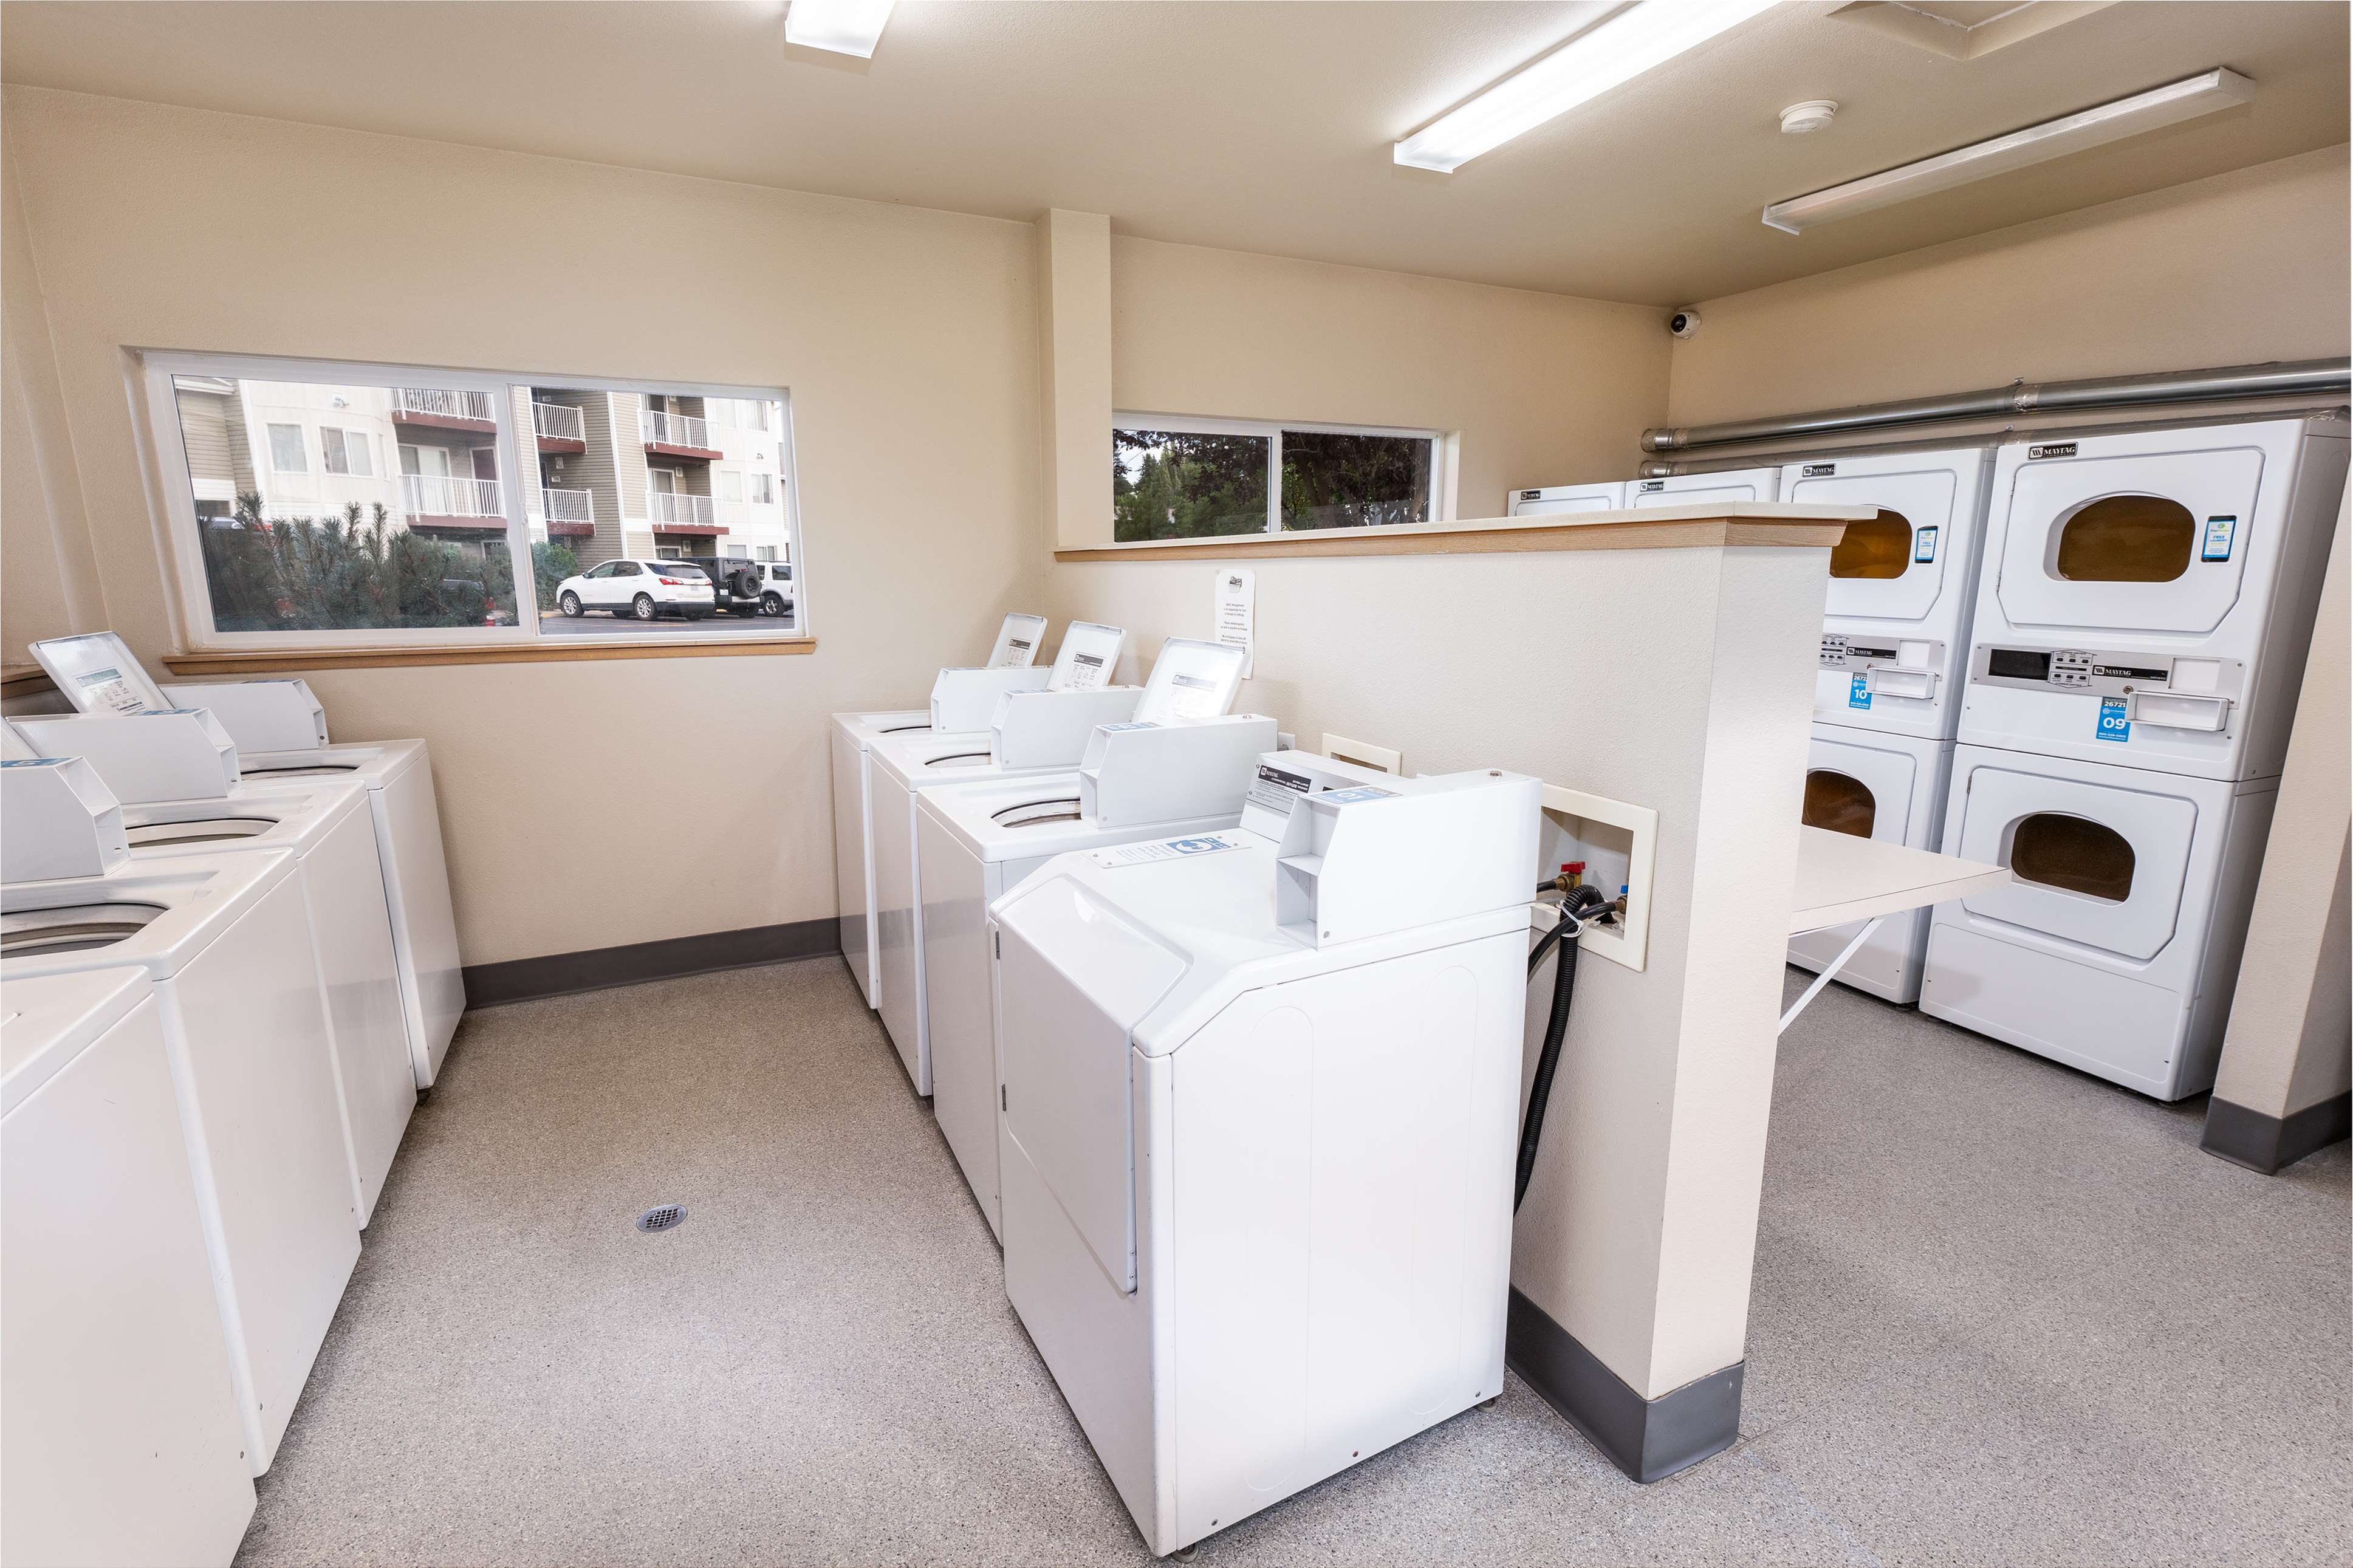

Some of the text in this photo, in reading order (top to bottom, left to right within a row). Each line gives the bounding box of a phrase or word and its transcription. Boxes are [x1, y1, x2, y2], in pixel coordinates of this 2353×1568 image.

[2043, 447, 2075, 455] MAYTAG
[1854, 689, 1868, 700] 10
[2103, 717, 2126, 730] 09
